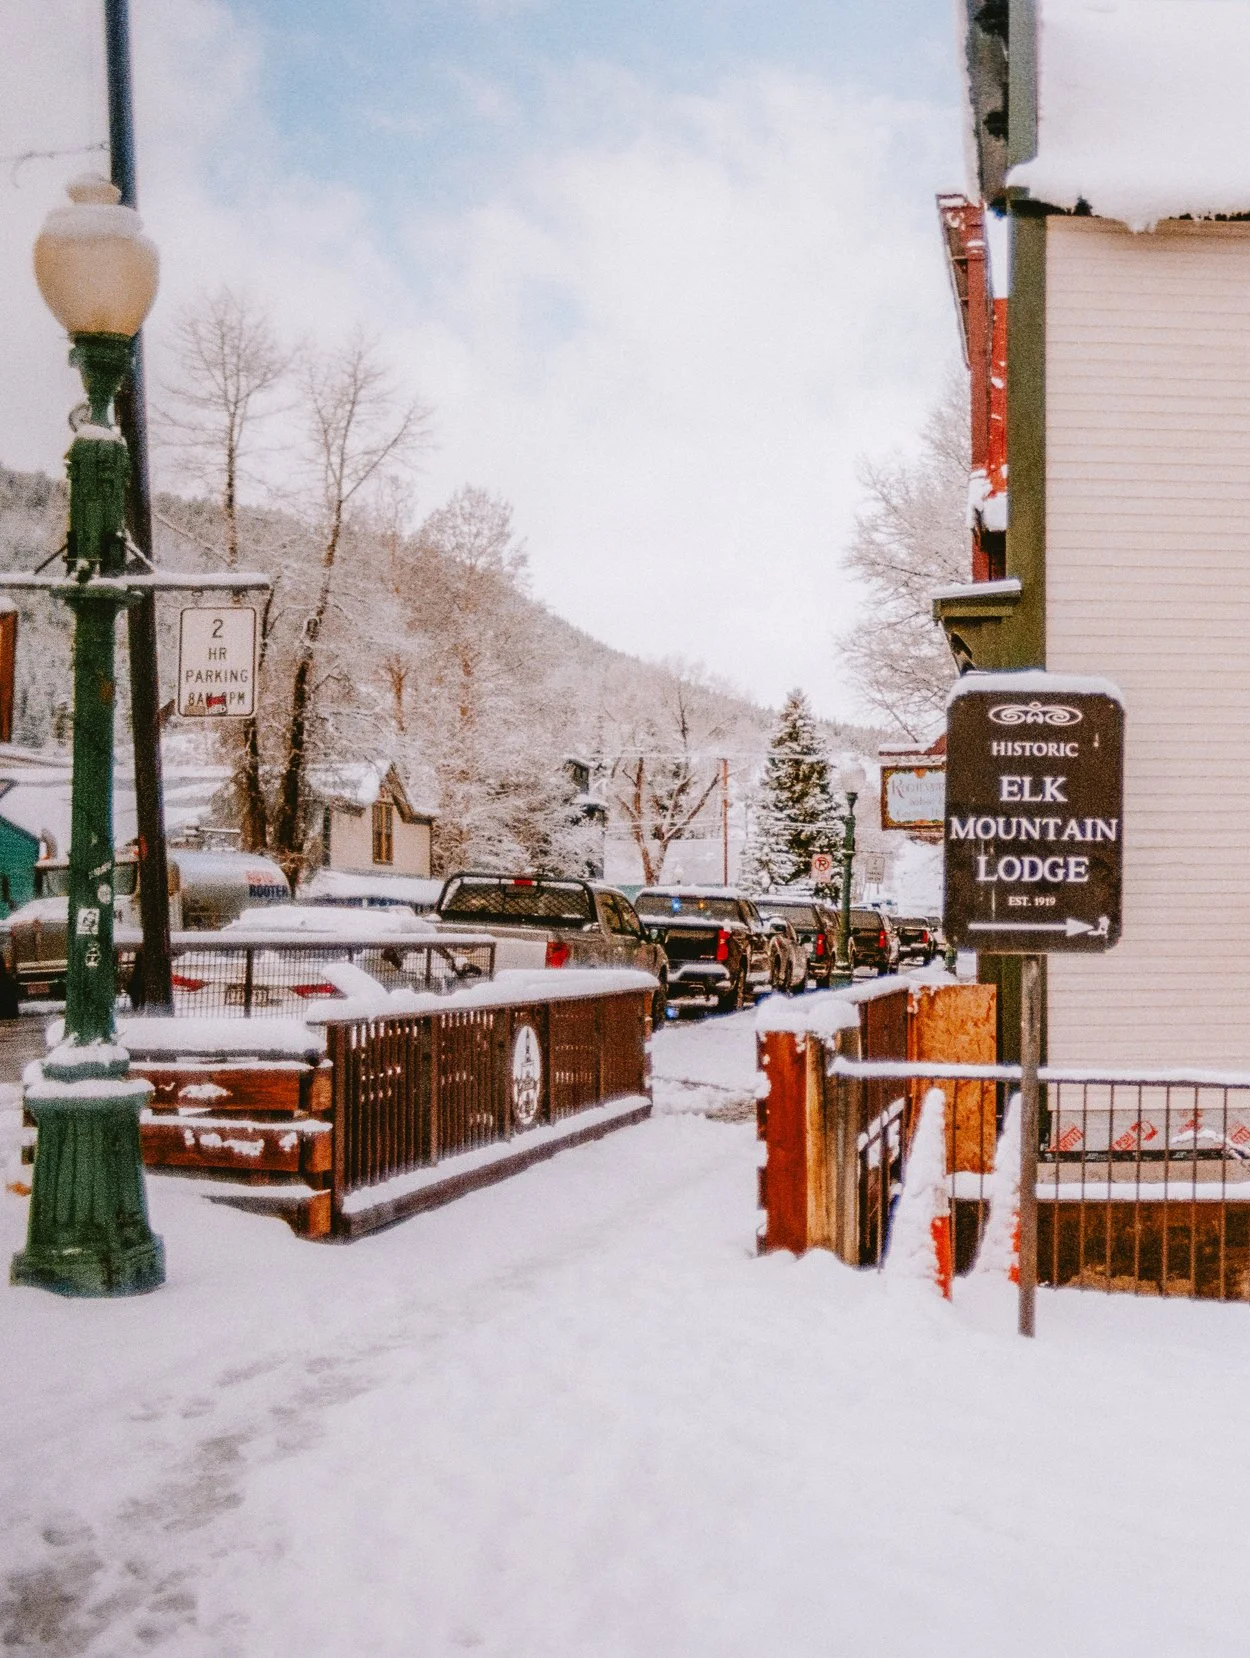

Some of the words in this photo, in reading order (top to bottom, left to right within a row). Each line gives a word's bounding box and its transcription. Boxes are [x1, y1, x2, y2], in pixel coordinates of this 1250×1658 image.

[211, 618, 224, 639] 2
[208, 647, 228, 660] HR
[184, 669, 249, 683] PARKING
[992, 741, 1079, 757] HISTORIC
[999, 776, 1068, 803] ELK
[949, 817, 1119, 842] MOUNTAIN
[976, 856, 1090, 883] LODGE
[1008, 896, 1031, 906] EST.
[1034, 896, 1056, 907] 1919
